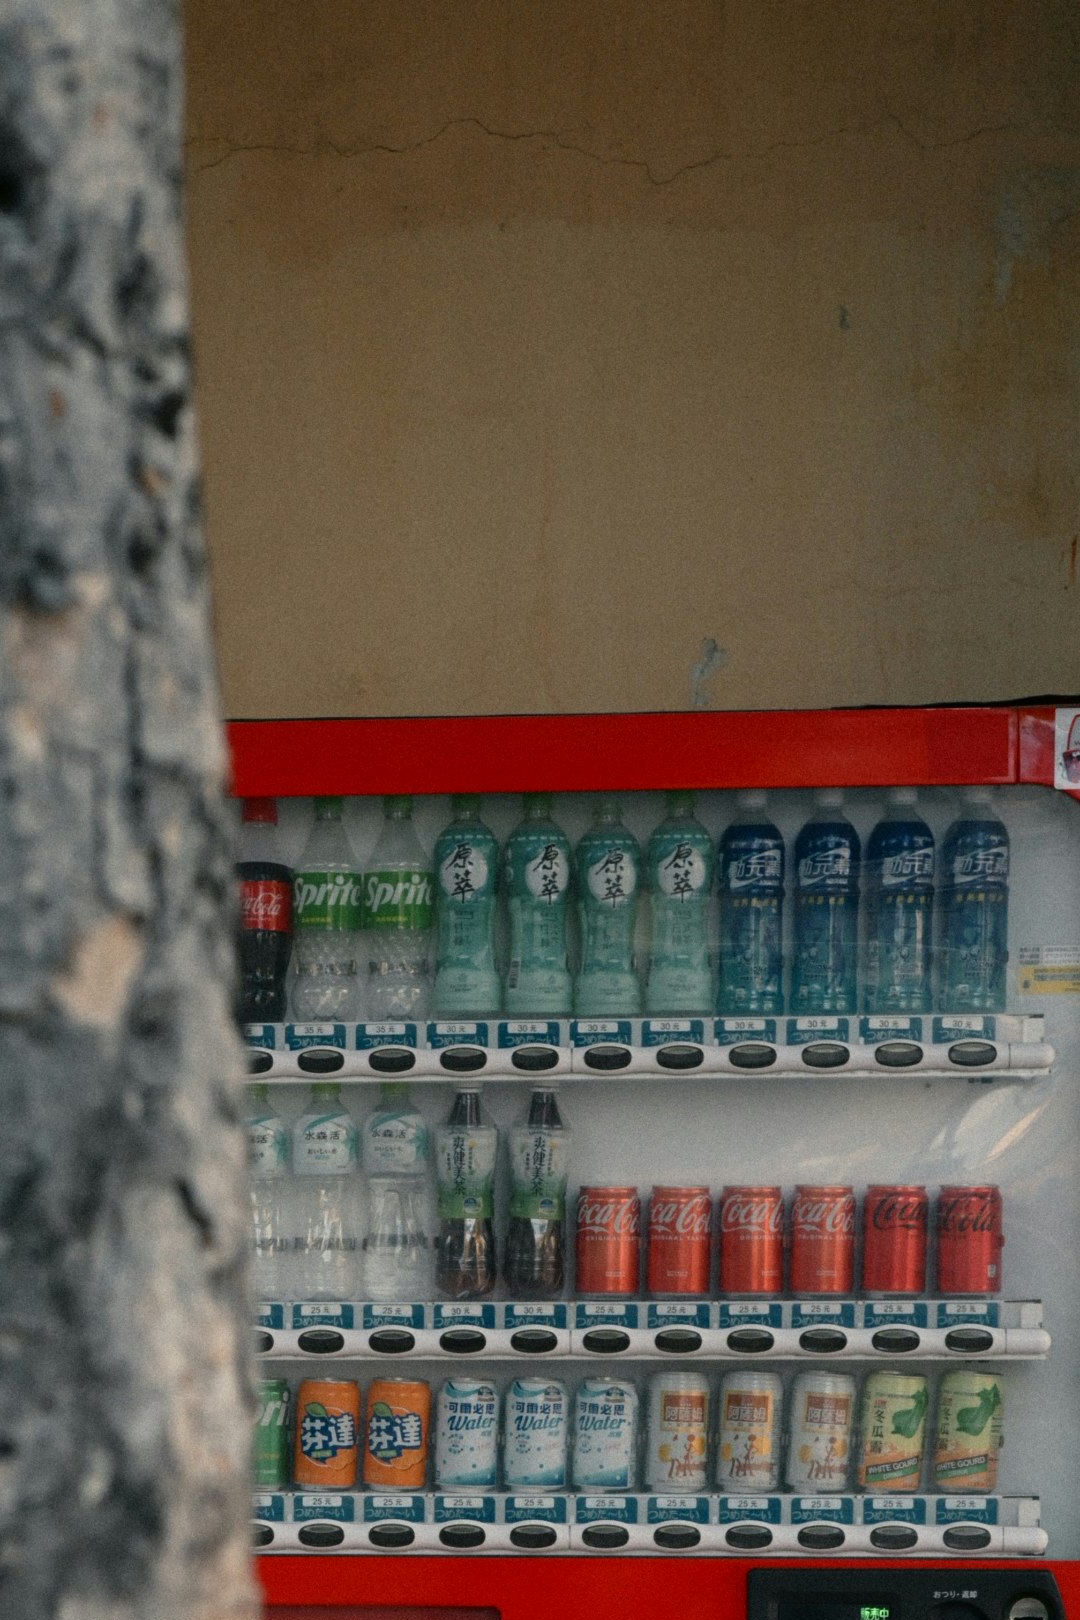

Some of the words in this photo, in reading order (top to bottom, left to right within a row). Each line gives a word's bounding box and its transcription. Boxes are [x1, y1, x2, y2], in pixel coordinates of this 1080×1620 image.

[446, 842, 475, 904] 原萃
[533, 844, 560, 906] 原萃
[596, 847, 626, 908] 原萃
[664, 842, 694, 903] 原萃
[448, 1402, 495, 1414] 可爾必思
[515, 1402, 562, 1414] 可爾必思
[448, 1415, 496, 1430] Water
[514, 1415, 564, 1430] Water
[578, 1415, 626, 1431] Water
[302, 1414, 354, 1450] 芬達
[370, 1413, 421, 1450] 芬達
[893, 1457, 918, 1470] GOURD
[956, 1456, 986, 1468] GOURD
[860, 1607, 890, 1620] 販売中
